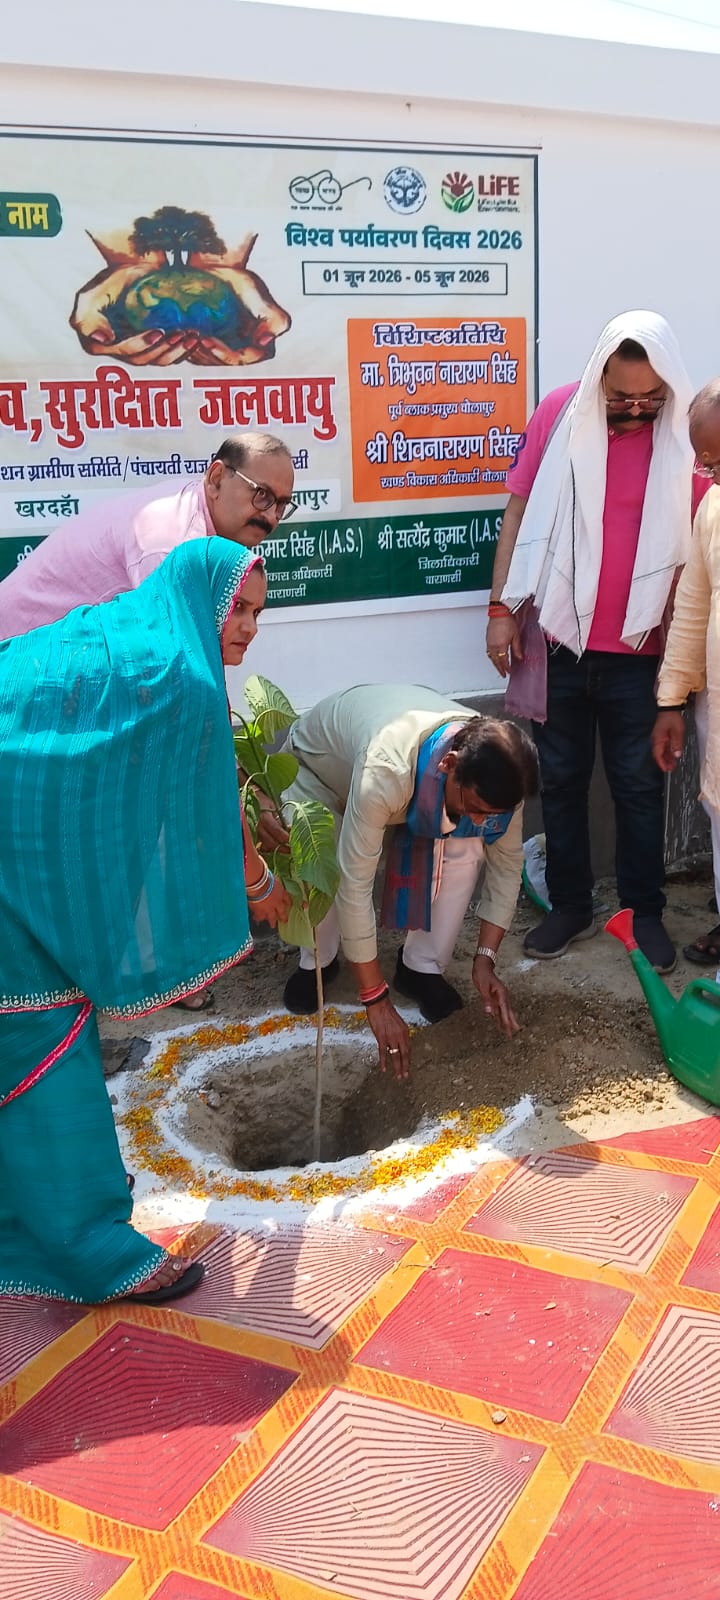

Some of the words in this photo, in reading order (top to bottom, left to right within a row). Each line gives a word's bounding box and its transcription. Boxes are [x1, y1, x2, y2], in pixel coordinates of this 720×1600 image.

[478, 174, 520, 196] LiFE
[6, 202, 49, 230] नाम
[285, 222, 334, 248] विश्व
[339, 223, 417, 249] पर्यावरण
[422, 225, 470, 250] दिवस
[477, 230, 523, 250] 2026
[323, 269, 340, 283] 01
[344, 270, 365, 288] जून
[369, 269, 402, 283] 2026
[414, 269, 431, 283] 05
[434, 270, 456, 288] जून
[460, 269, 490, 284] 2026
[360, 361, 385, 387] मा.
[387, 353, 436, 395] त्रिभुवन
[439, 358, 488, 386] नारायण
[491, 351, 518, 385] सिंह
[193, 376, 337, 440] जलवायु
[365, 431, 389, 465] श्री
[392, 430, 485, 463] शिवनारायण
[488, 425, 522, 460] सिंह
[27, 457, 75, 482] ग्रामीण
[407, 471, 438, 487] विकास
[439, 468, 480, 486] अधिकारी
[290, 529, 316, 558] सिंह
[318, 526, 364, 562] (I.A.S.)
[377, 524, 394, 550] श्री
[396, 520, 432, 549] सत्येंद्र
[433, 524, 468, 553] कुमार
[470, 516, 503, 550] (I.A.S
[292, 564, 333, 580] अधिकारी
[417, 552, 480, 570] जिलाधिकारी
[425, 569, 462, 585] वाराणसी
[266, 584, 307, 599] वाराणसी
